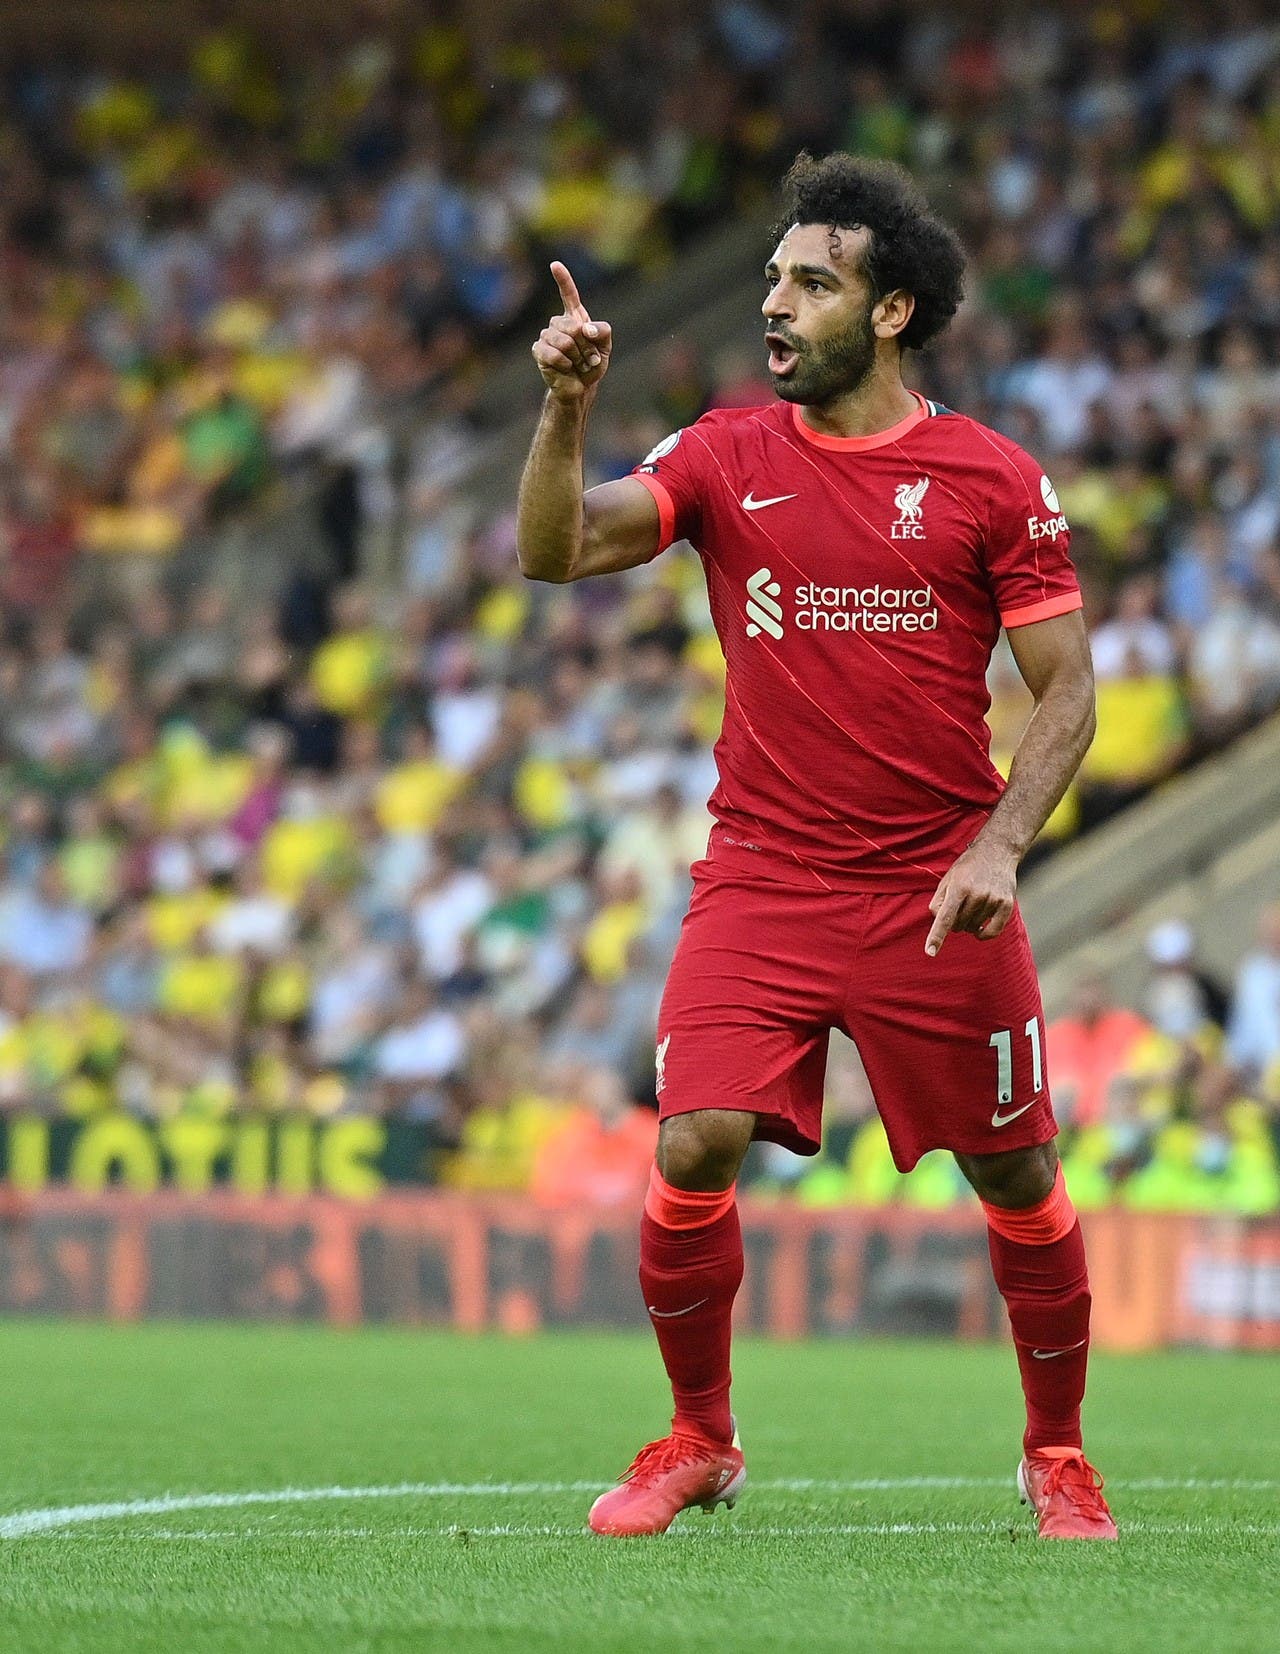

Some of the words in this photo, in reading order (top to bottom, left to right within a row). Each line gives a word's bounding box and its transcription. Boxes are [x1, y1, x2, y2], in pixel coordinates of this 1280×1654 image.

[795, 581, 932, 609] standard
[795, 606, 938, 633] chartered
[988, 1016, 1042, 1104] 11
